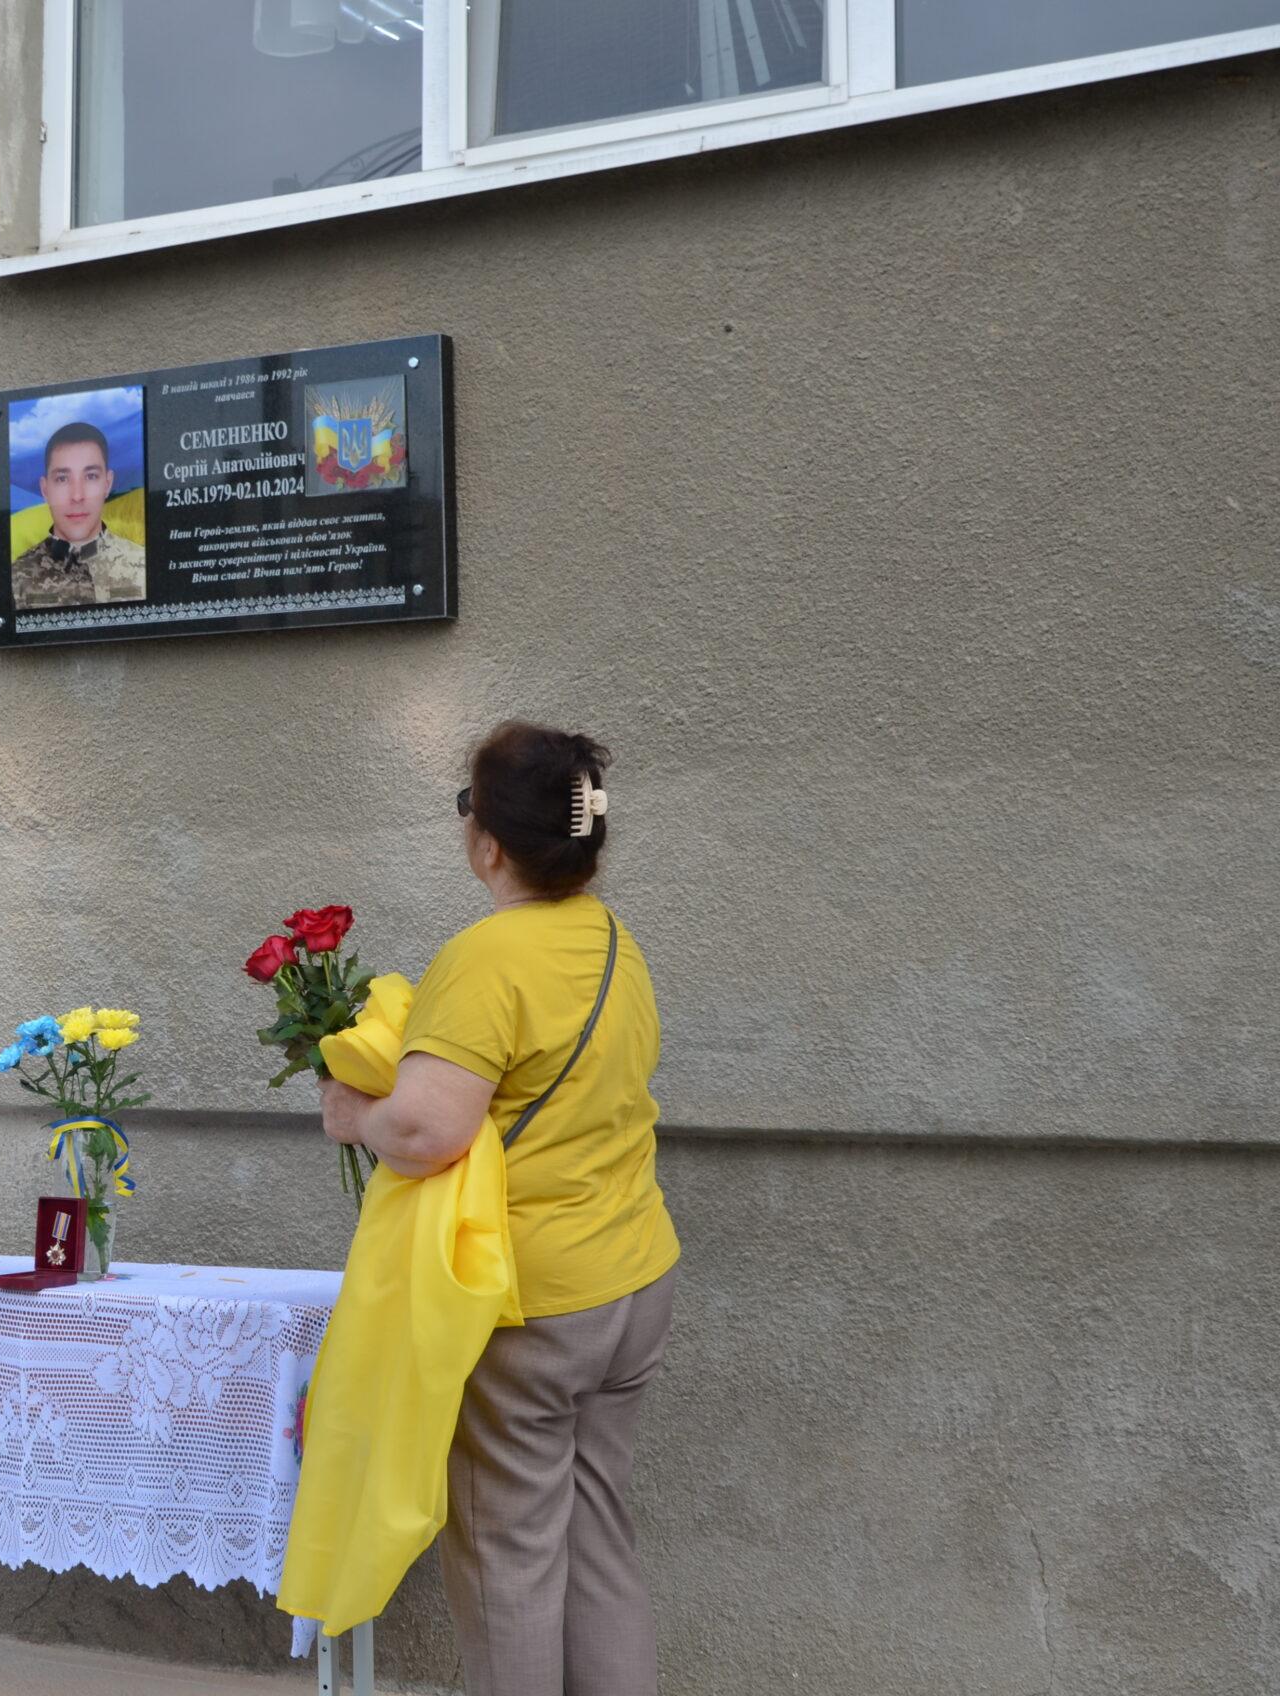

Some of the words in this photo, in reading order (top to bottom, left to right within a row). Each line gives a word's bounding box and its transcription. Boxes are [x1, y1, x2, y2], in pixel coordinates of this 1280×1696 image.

[161, 384, 169, 395] В
[170, 381, 198, 394] нашій
[200, 377, 227, 390] школі
[235, 373, 256, 386] 1986
[257, 373, 269, 383] по
[271, 368, 292, 381] 1992
[292, 367, 308, 381] рік
[214, 390, 256, 403] навчався
[180, 420, 288, 451] СЕМЕНЕНКО
[163, 459, 208, 483] Сергій
[211, 452, 306, 475] Анатолійович
[166, 476, 304, 507] 25.05.1979-02.10.2024
[169, 529, 192, 540] Наш
[193, 524, 260, 540] Герой-земляк,
[261, 519, 286, 532] який
[287, 516, 318, 530] віддав
[341, 512, 385, 524] життя,
[168, 560, 177, 571] із
[177, 558, 217, 569] захисту
[218, 553, 283, 568] суверенітету
[290, 545, 342, 562] цілісності
[344, 541, 387, 557] України.
[198, 540, 250, 553] виконуючи
[251, 535, 303, 548] військовий
[191, 572, 219, 584] Вічна
[220, 568, 251, 582] слава!
[253, 566, 281, 579] Вічна
[327, 558, 364, 575] Герою!
